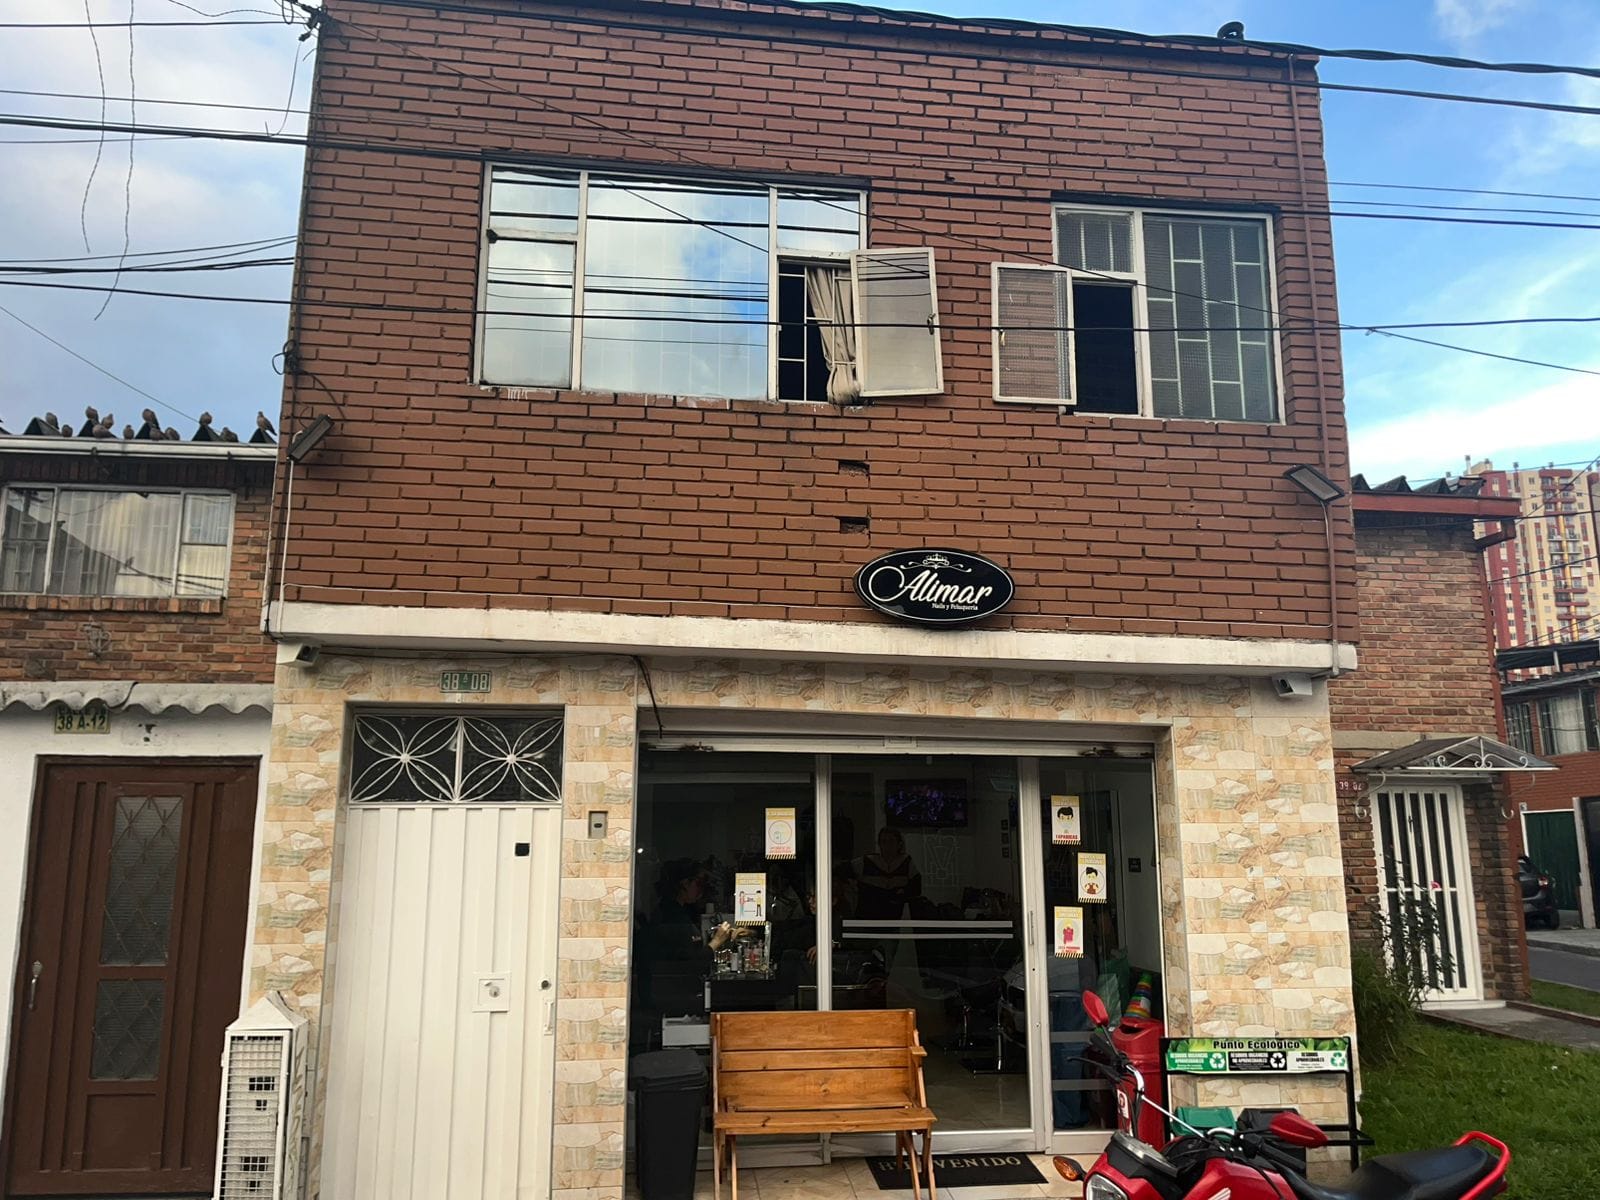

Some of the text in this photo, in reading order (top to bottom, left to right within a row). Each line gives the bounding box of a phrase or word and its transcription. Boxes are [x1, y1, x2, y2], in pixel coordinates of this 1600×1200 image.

[868, 565, 993, 604] Alimar
[443, 674, 459, 690] 38
[471, 674, 488, 690] 08
[58, 715, 73, 730] 38
[1213, 1040, 1244, 1049] Punto
